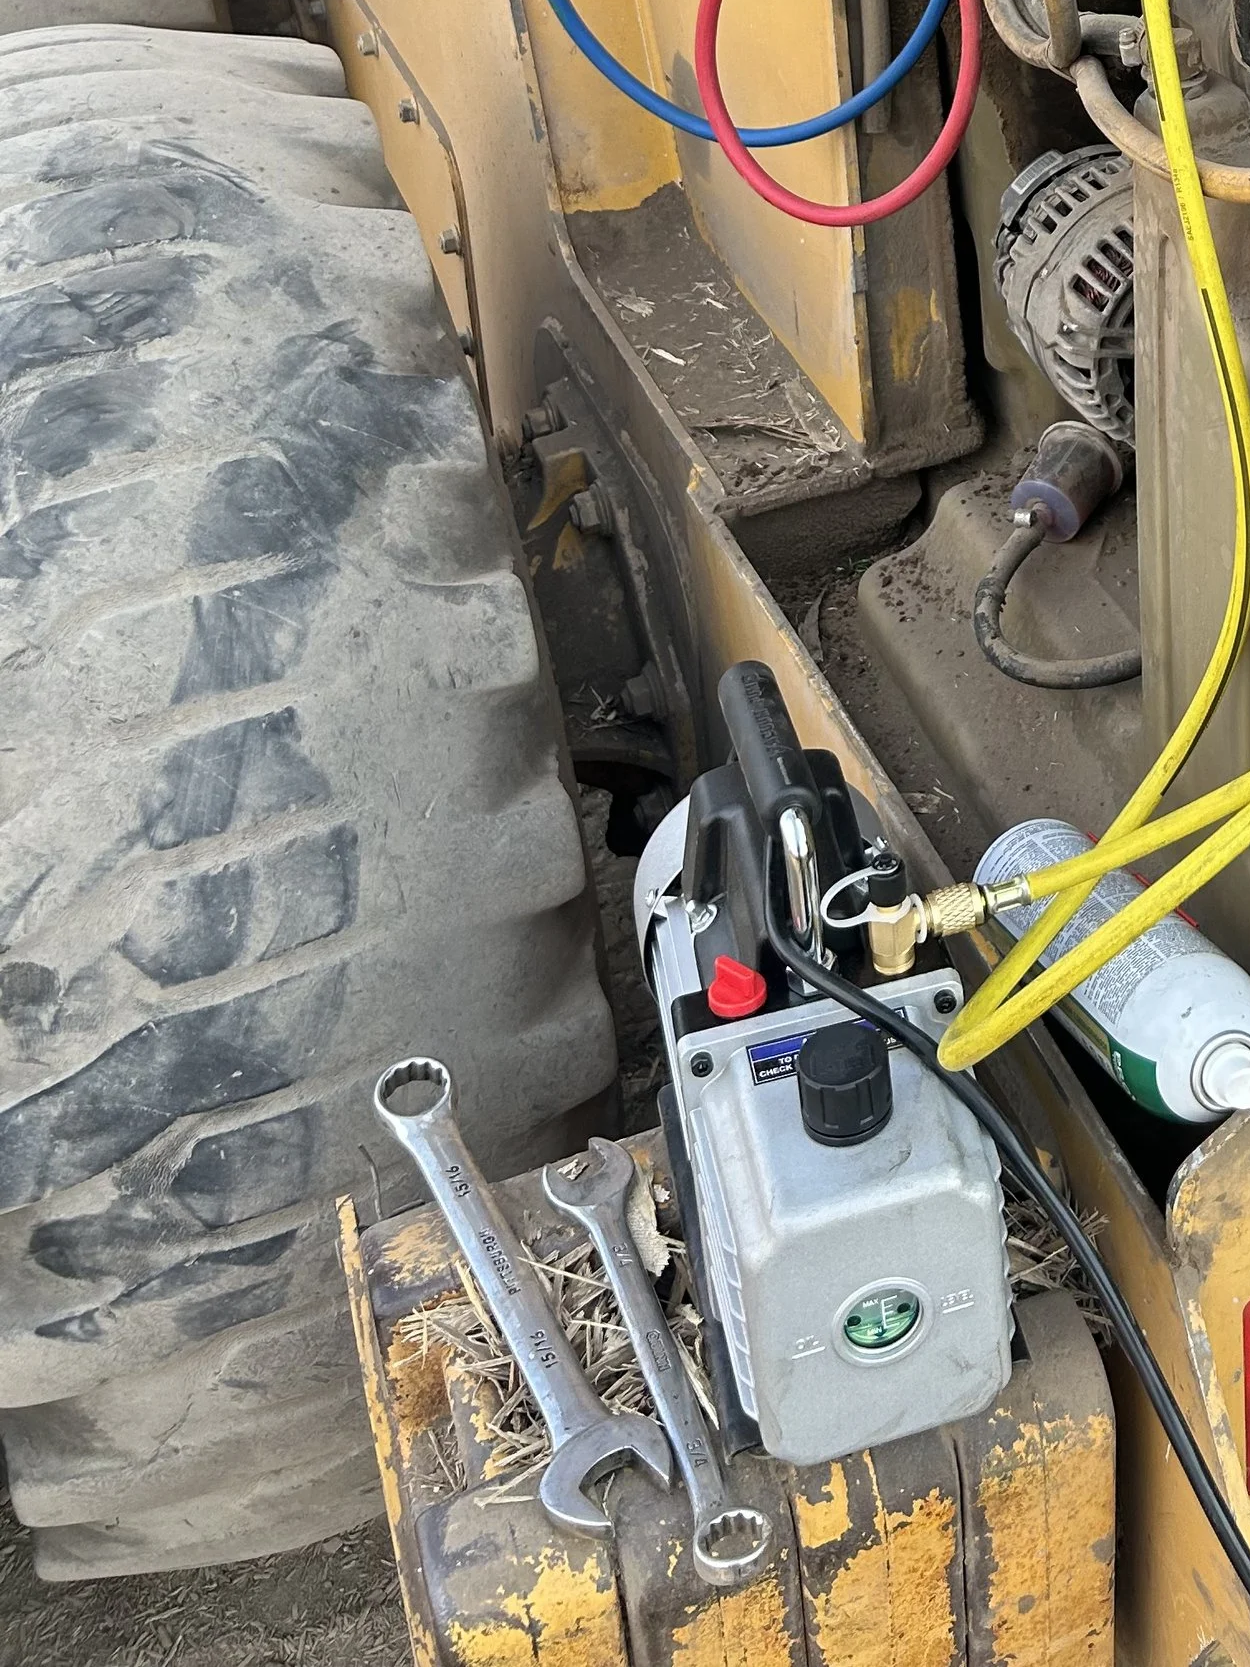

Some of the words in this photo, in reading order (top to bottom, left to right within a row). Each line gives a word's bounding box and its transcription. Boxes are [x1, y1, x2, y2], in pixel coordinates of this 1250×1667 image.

[759, 1064, 793, 1078] CHECK
[779, 1057, 792, 1065] TO
[446, 1166, 472, 1198] 15/16
[478, 1226, 522, 1296] PITTSBURGH
[612, 1242, 633, 1268] 3/4
[862, 1298, 879, 1308] MAX
[866, 1327, 882, 1335] MIN
[530, 1329, 558, 1369] 15/16
[687, 1437, 708, 1468] 3/4
